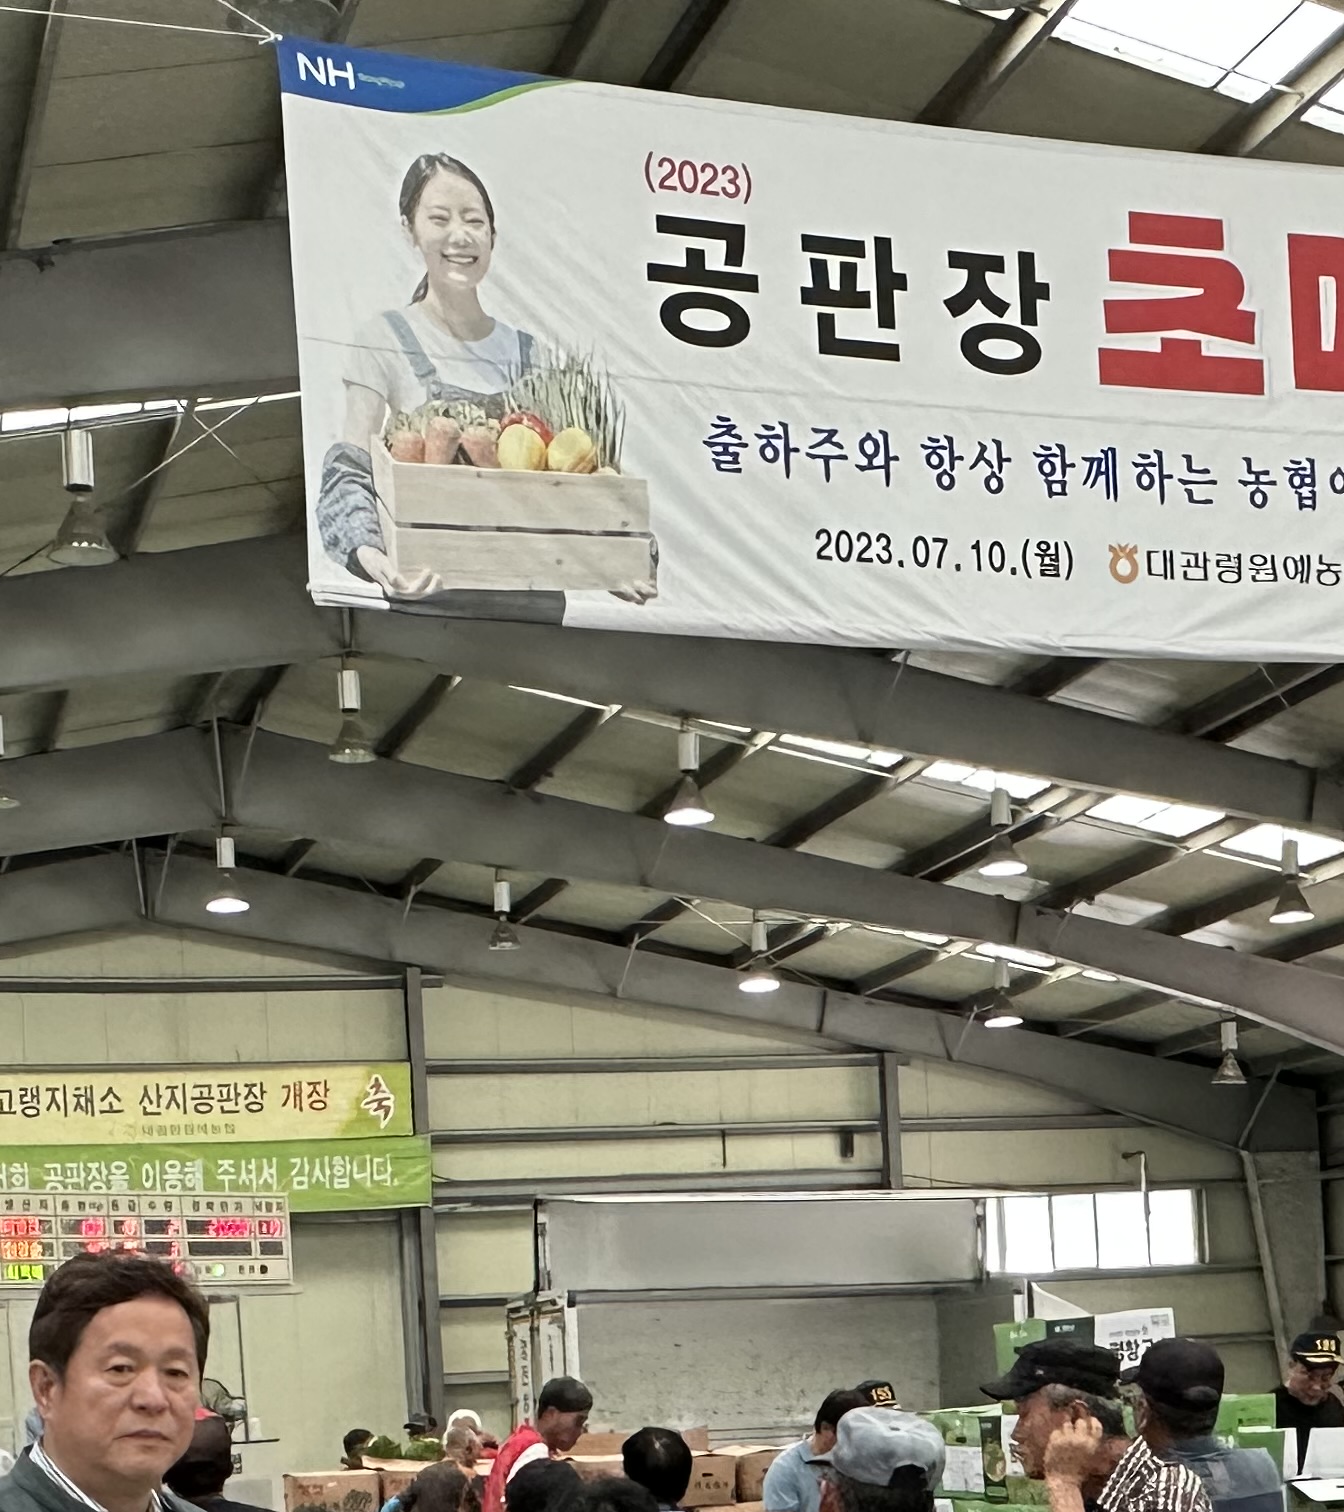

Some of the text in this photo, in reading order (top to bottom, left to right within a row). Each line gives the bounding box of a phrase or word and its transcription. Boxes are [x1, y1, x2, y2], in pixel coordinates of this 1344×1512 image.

[296, 52, 356, 91] NH
[644, 151, 752, 205] (2023)
[702, 415, 900, 488] 출하주와
[920, 434, 1012, 495] 항상
[139, 1081, 268, 1116] 산지공판장
[281, 1079, 331, 1113] 개장
[360, 1074, 394, 1129] 축
[216, 1157, 278, 1193] 주셔서
[290, 1153, 399, 1190] 감사합니다.
